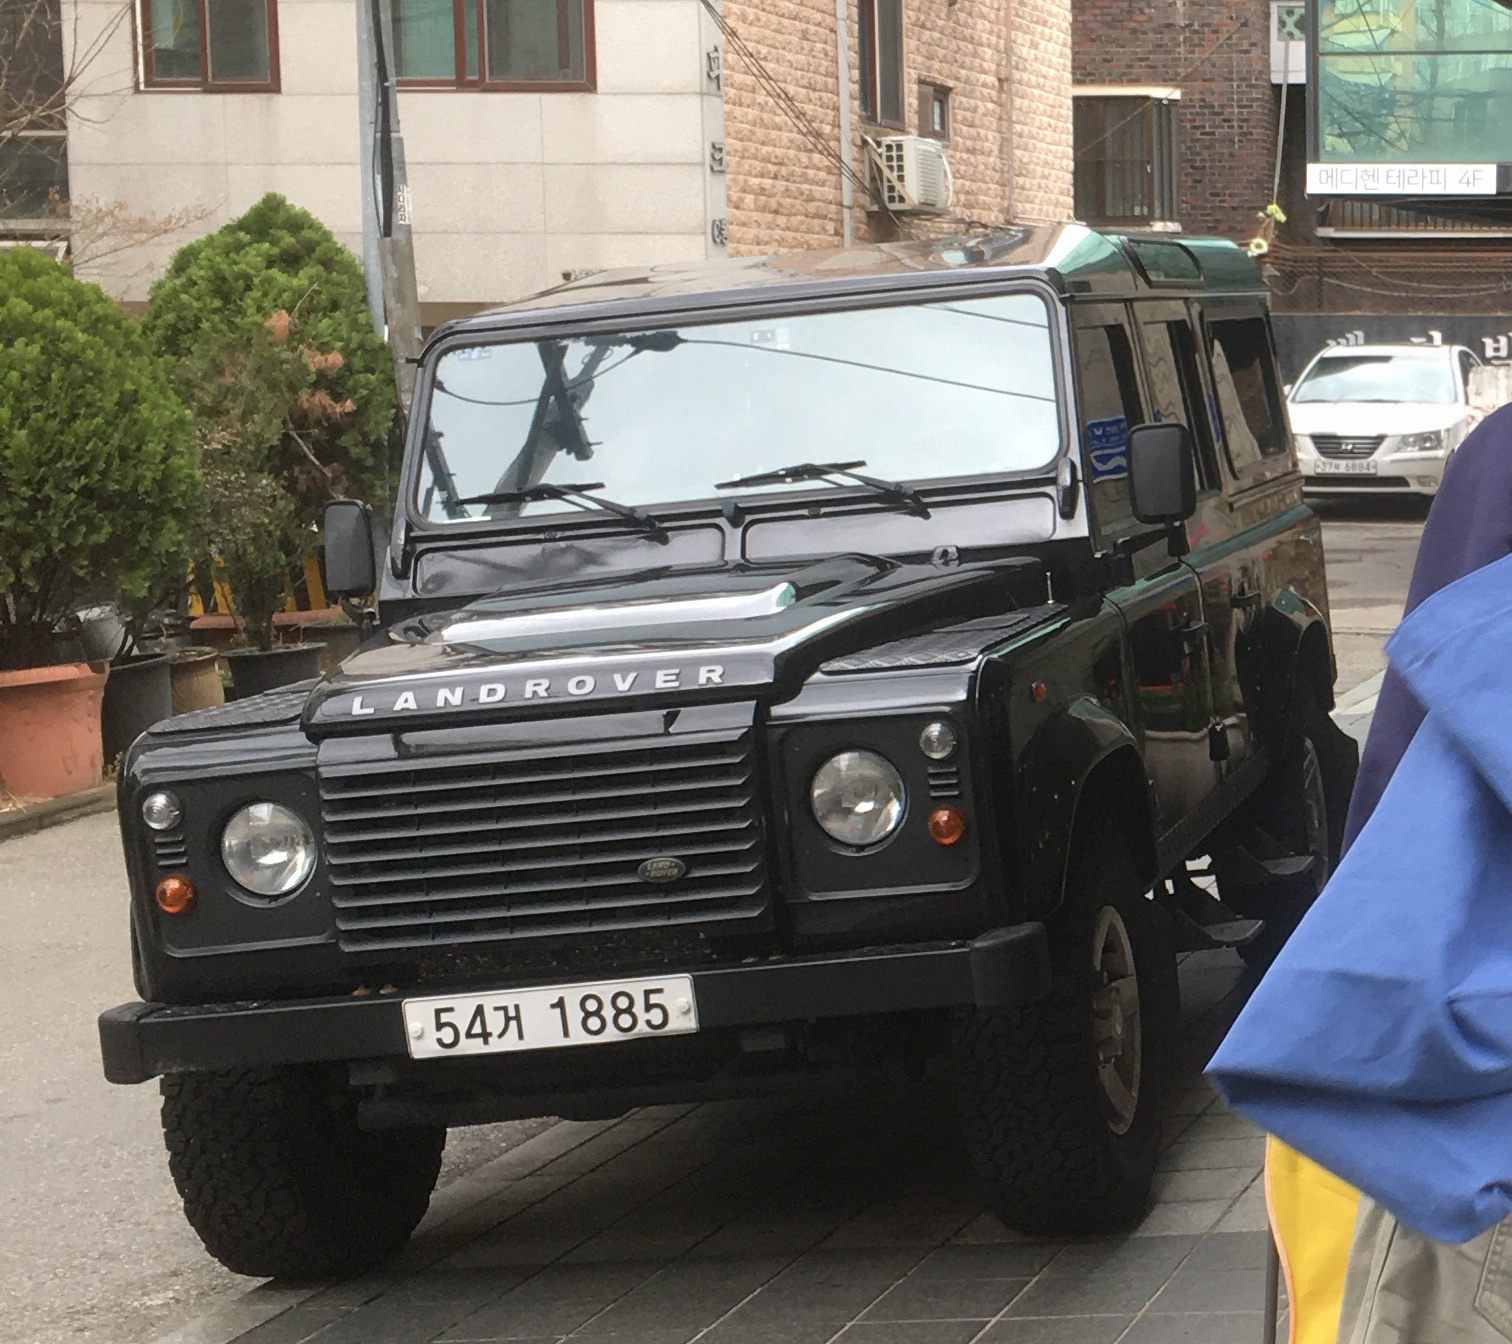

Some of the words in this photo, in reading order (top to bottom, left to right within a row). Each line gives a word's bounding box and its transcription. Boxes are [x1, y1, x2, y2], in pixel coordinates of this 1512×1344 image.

[1318, 167, 1380, 191] 메디헨
[1386, 167, 1447, 191] 테라피
[1458, 169, 1485, 189] 4F
[433, 1003, 525, 1050] 54거
[549, 987, 671, 1038] 1885
